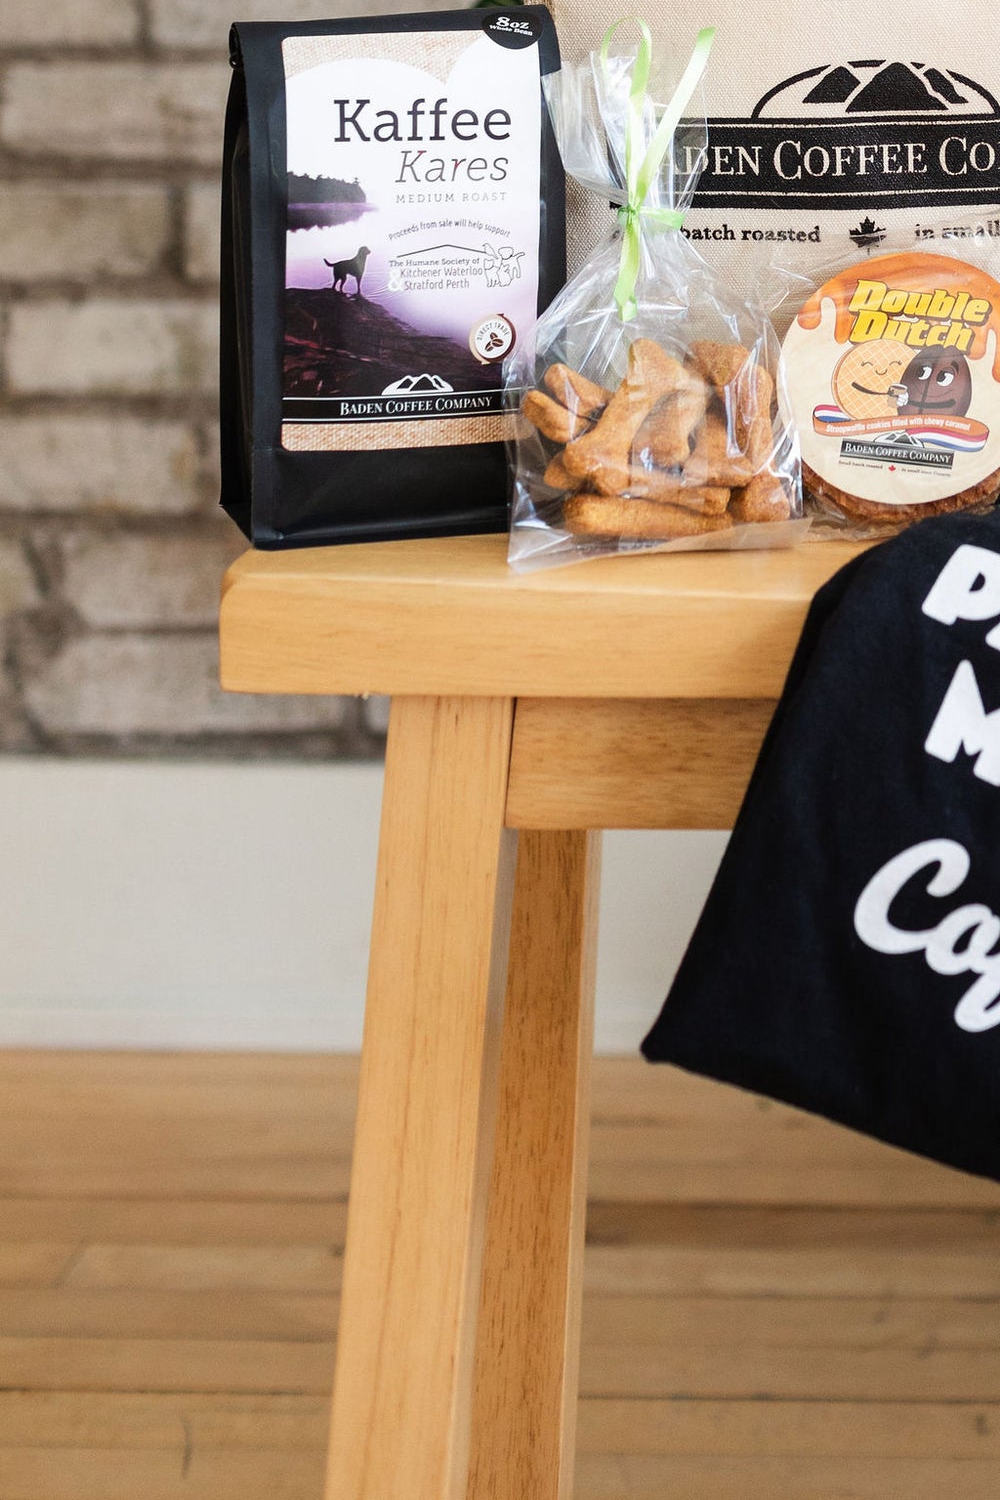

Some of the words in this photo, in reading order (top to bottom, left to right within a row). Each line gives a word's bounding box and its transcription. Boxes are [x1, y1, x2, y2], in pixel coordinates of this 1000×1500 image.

[495, 16, 529, 29] 8oz
[334, 98, 512, 142] Kaffee
[395, 150, 509, 183] Kares
[773, 140, 928, 180] COFFEE
[396, 193, 455, 203] MEDIUM
[462, 192, 507, 202] ROAST
[420, 221, 437, 229] from
[439, 220, 452, 228] sale
[454, 219, 466, 227] will
[468, 219, 483, 230] help
[485, 224, 511, 237] support
[741, 225, 821, 243] roasted
[400, 268, 441, 277] Kitchener
[443, 267, 483, 277] Waterloo
[441, 258, 470, 267] Society
[404, 280, 444, 291] Stratford
[446, 279, 470, 289] Perth
[848, 278, 993, 326] Double
[849, 309, 976, 354] Dutch
[340, 402, 383, 416] BADEN
[386, 399, 433, 414] COFFEE
[435, 396, 493, 411] COMPANY
[845, 442, 874, 454] BADEN
[875, 446, 908, 458] COFFEE
[909, 450, 951, 464] COMPANY
